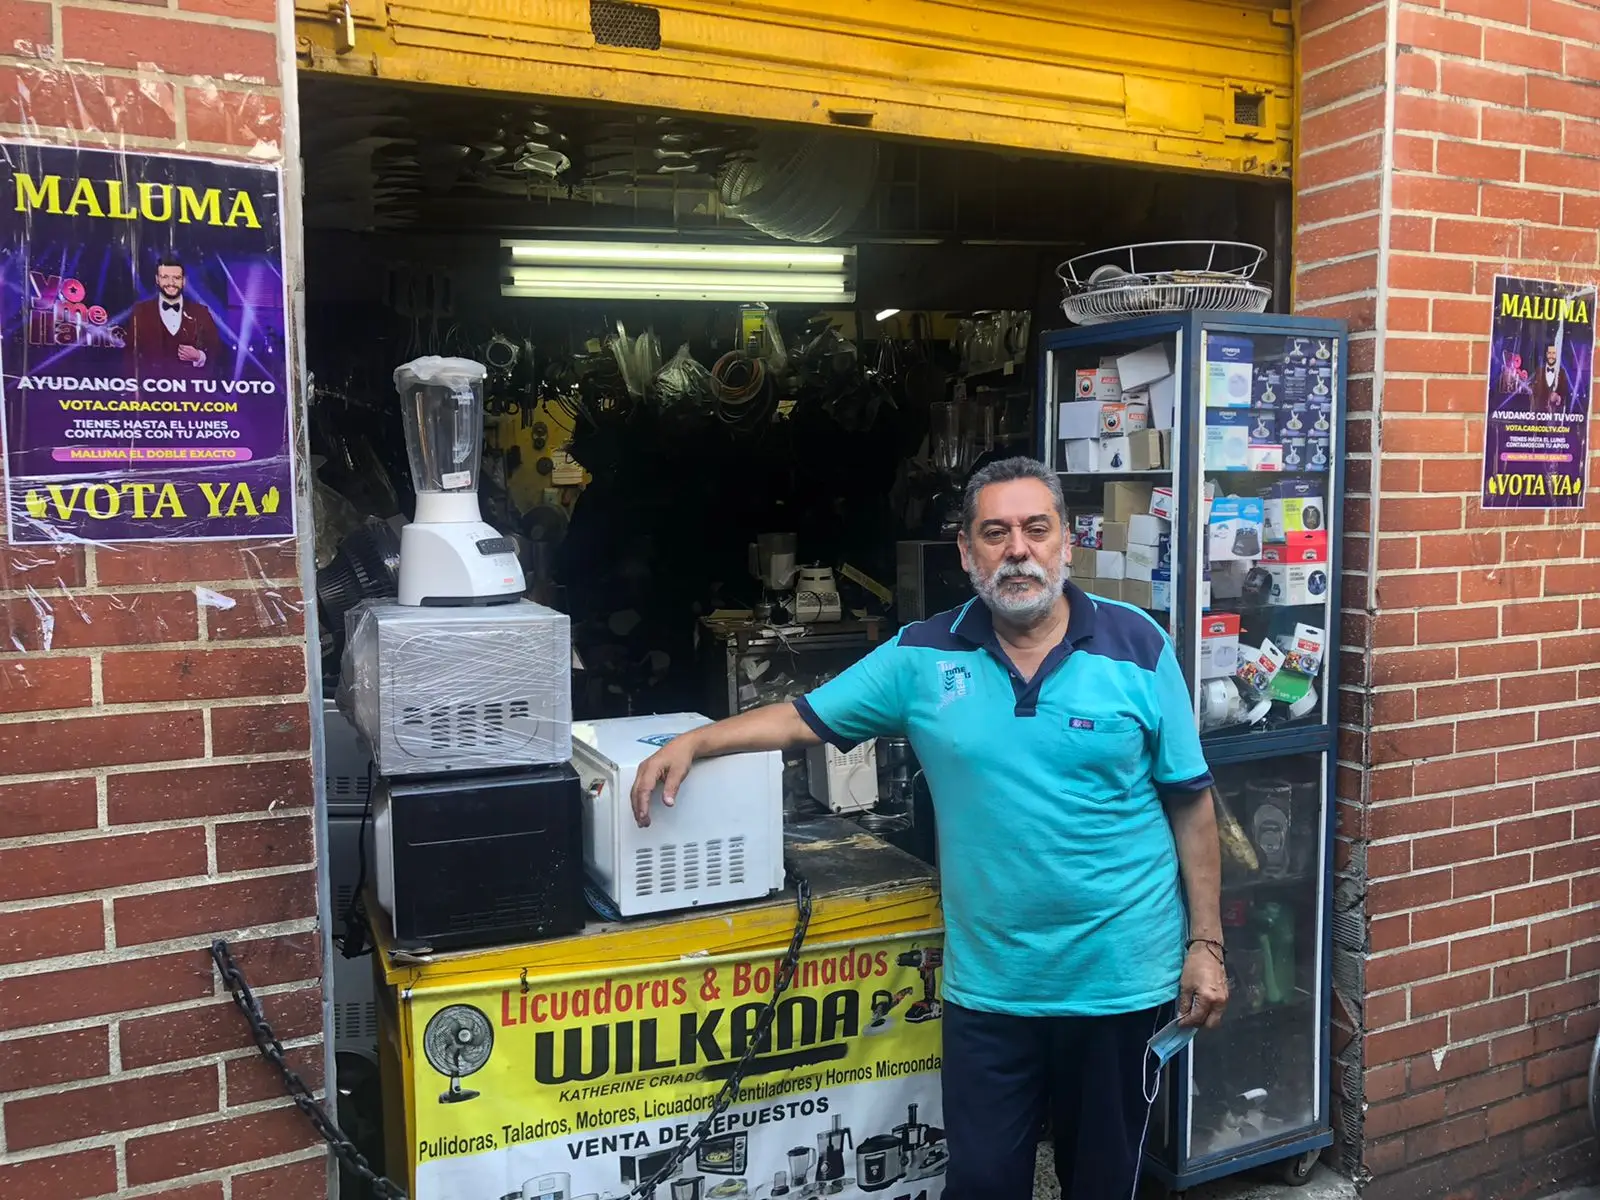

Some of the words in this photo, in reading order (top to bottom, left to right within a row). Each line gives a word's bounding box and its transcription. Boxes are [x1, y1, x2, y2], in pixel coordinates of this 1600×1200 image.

[13, 173, 262, 229] MALUMA
[1501, 293, 1589, 324] MALUMA
[17, 376, 138, 392] AYUDANOS
[143, 378, 187, 393] CON
[191, 379, 219, 393] TU
[221, 380, 276, 394] VOTO
[59, 399, 238, 413] VOTA.CARACOLTV.COM
[1492, 411, 1535, 421] AYUDANOS
[1536, 412, 1553, 421] CON
[1554, 413, 1565, 421] TU
[1565, 414, 1585, 422] VOTO
[64, 429, 142, 439] CONTAMOS
[144, 429, 173, 439] CON
[175, 429, 193, 439] TU
[196, 429, 240, 439] APOYO
[73, 419, 120, 429] TIENES
[123, 419, 167, 430] HASTA
[170, 420, 185, 430] EL
[188, 420, 229, 430] LUNES
[71, 450, 128, 459] MALUMA
[130, 450, 145, 459] EL
[147, 450, 188, 459] DOBLE
[190, 449, 237, 459] EXACTO
[1496, 474, 1546, 496] VOTA
[1550, 474, 1573, 496] YA
[45, 483, 188, 520] VOTA
[198, 482, 260, 518] YA
[501, 976, 687, 1027] Licuadoras
[700, 967, 720, 1002] &
[535, 989, 859, 1085] WILKANA
[559, 1079, 645, 1103] KATHERINE
[419, 1133, 498, 1161] Pulidoras,
[502, 1118, 572, 1145] Taladros,
[576, 1106, 640, 1130] Motores,
[644, 1092, 721, 1119] Licuadora
[729, 1075, 812, 1103] entiladores
[815, 1073, 823, 1092] y
[826, 1066, 872, 1086] Hornos
[567, 1131, 650, 1160] VENTA
[659, 1124, 689, 1144] DE
